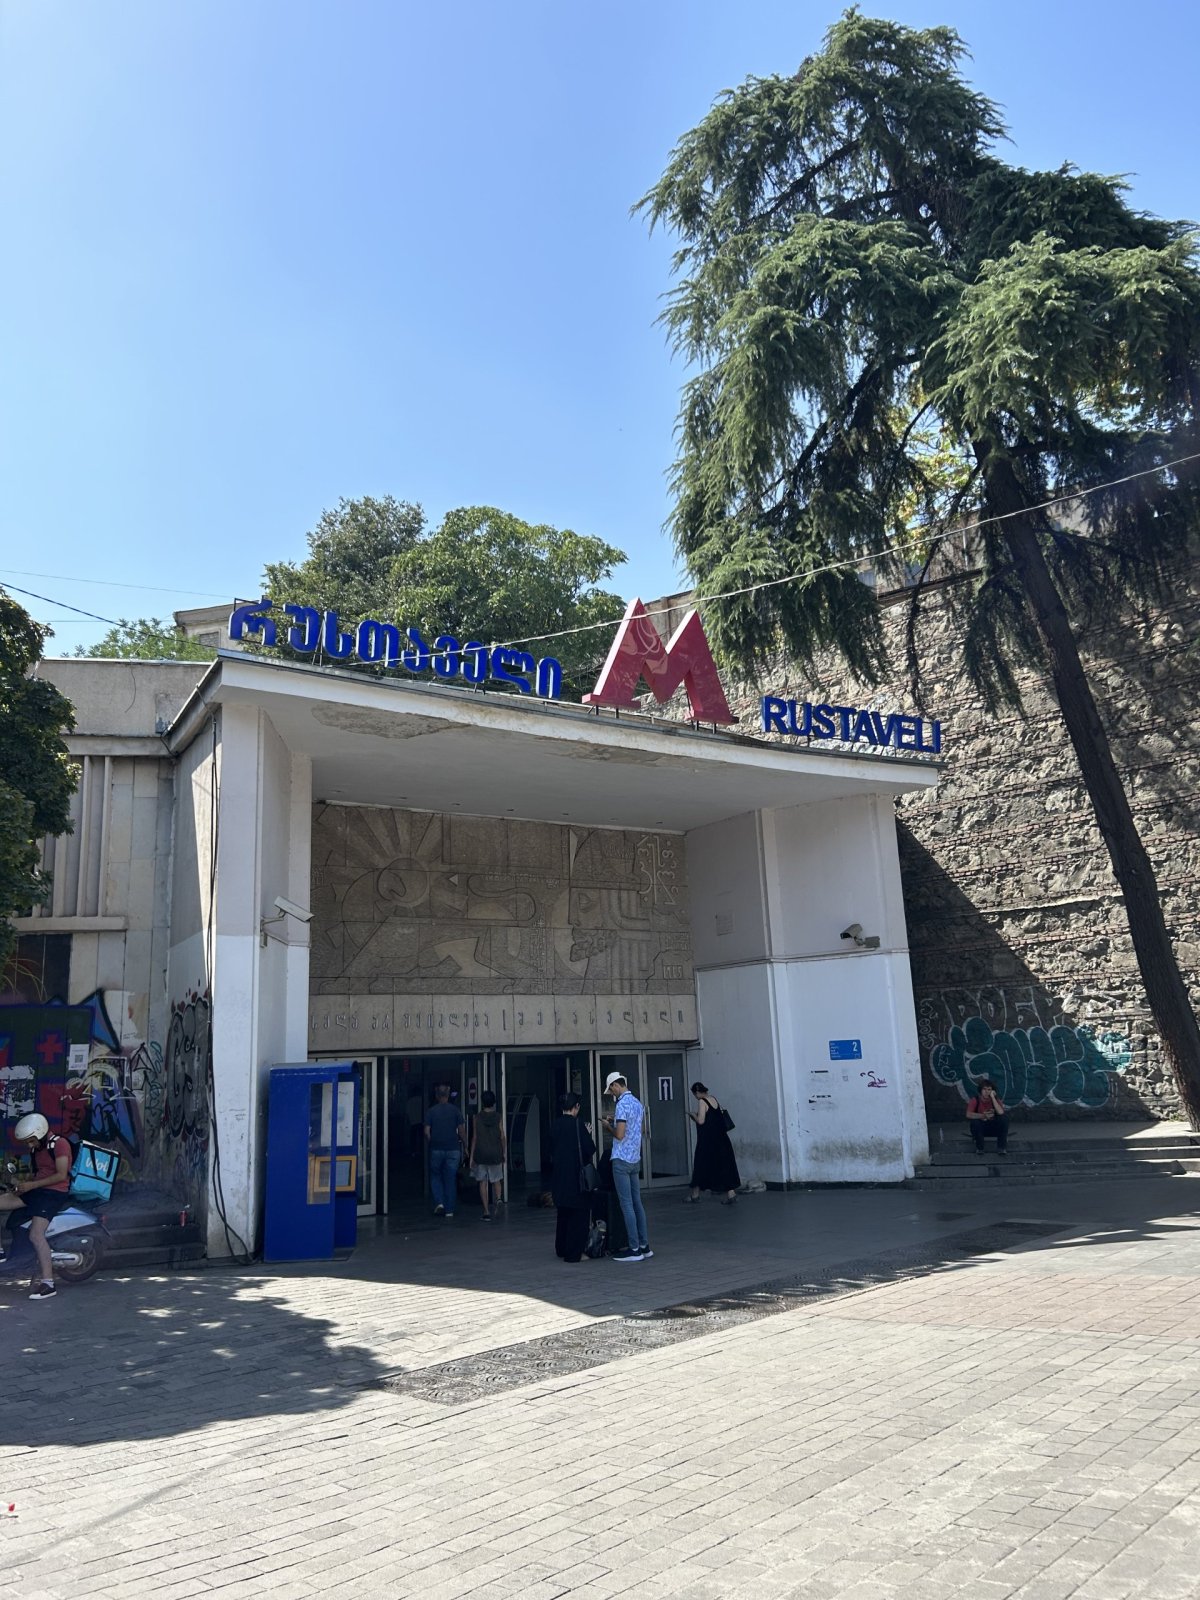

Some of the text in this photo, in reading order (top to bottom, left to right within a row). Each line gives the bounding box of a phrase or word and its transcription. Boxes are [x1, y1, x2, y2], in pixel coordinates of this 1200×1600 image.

[228, 597, 563, 699] რუსთაველი
[761, 695, 941, 754] RUSTAVELI
[852, 1041, 859, 1052] 2
[85, 1157, 109, 1173] Wol
